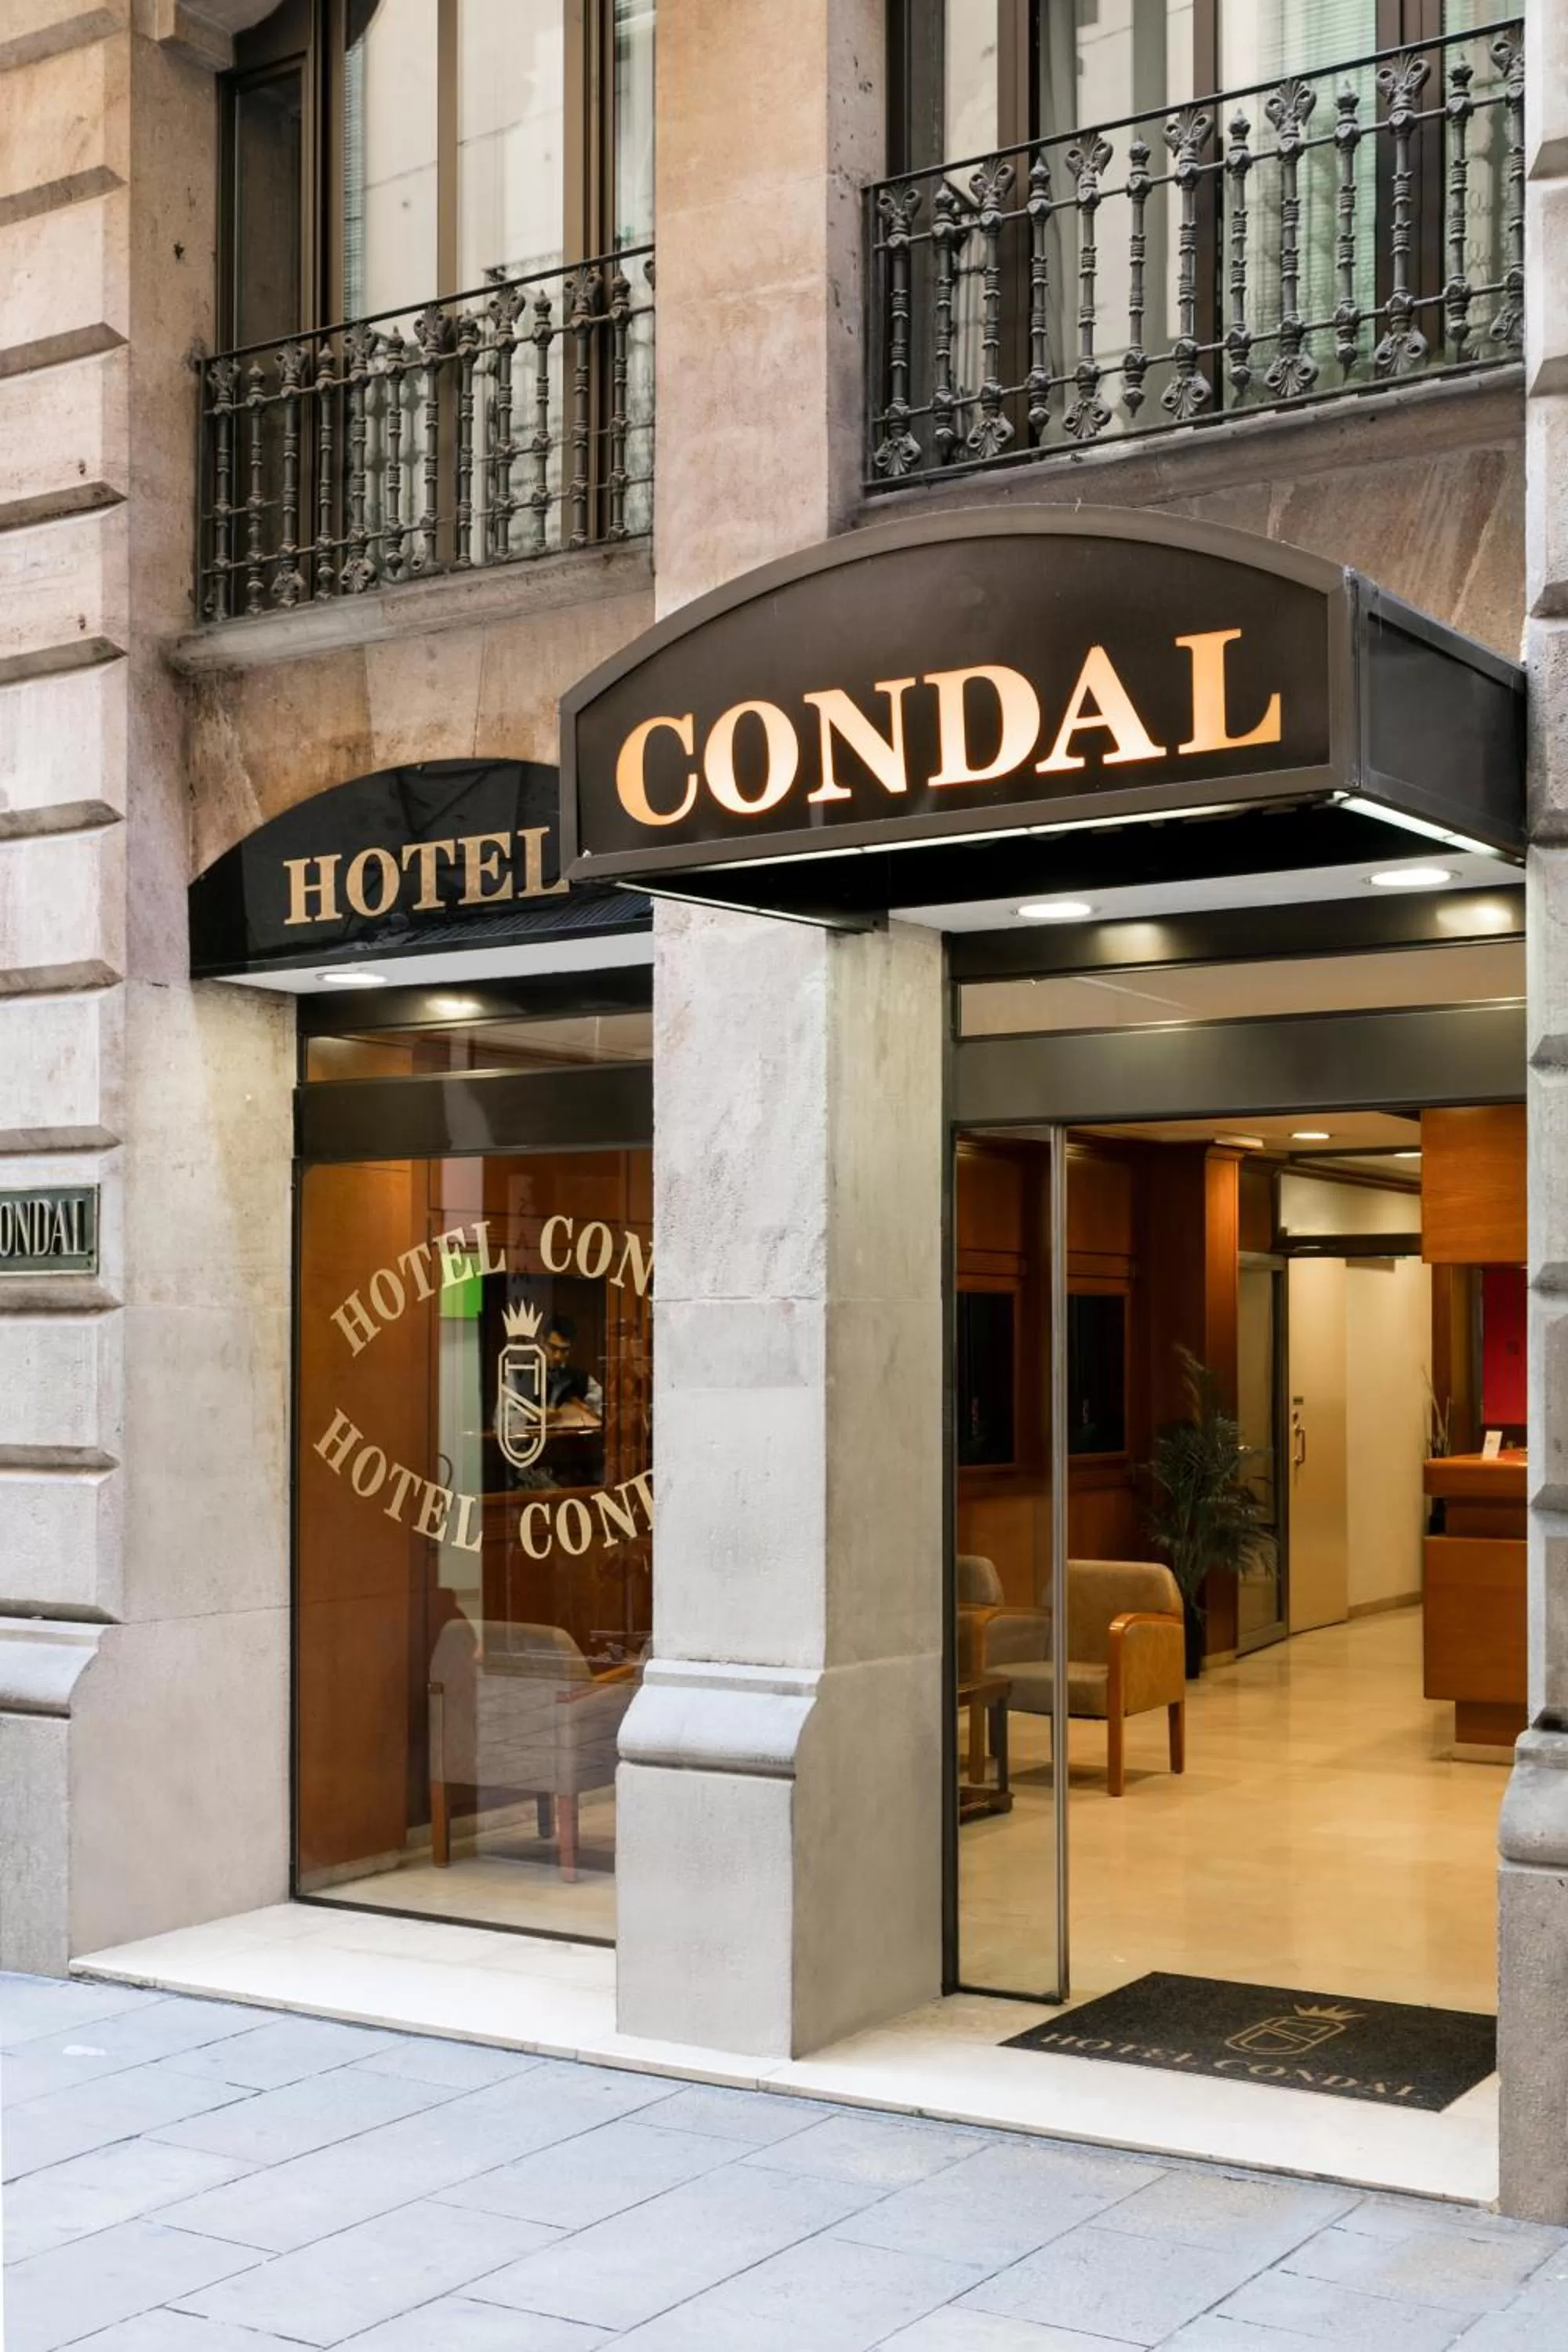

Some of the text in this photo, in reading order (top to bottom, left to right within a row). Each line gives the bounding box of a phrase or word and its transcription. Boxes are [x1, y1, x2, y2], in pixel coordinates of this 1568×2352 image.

[615, 629, 1281, 826] CONDAL
[283, 826, 569, 925] HOTEL
[330, 1221, 506, 1356] HOTEL
[540, 1214, 654, 1302] CON
[313, 1408, 483, 1552] HOTEL
[1040, 2032, 1425, 2099] HOTEL CONDAL
